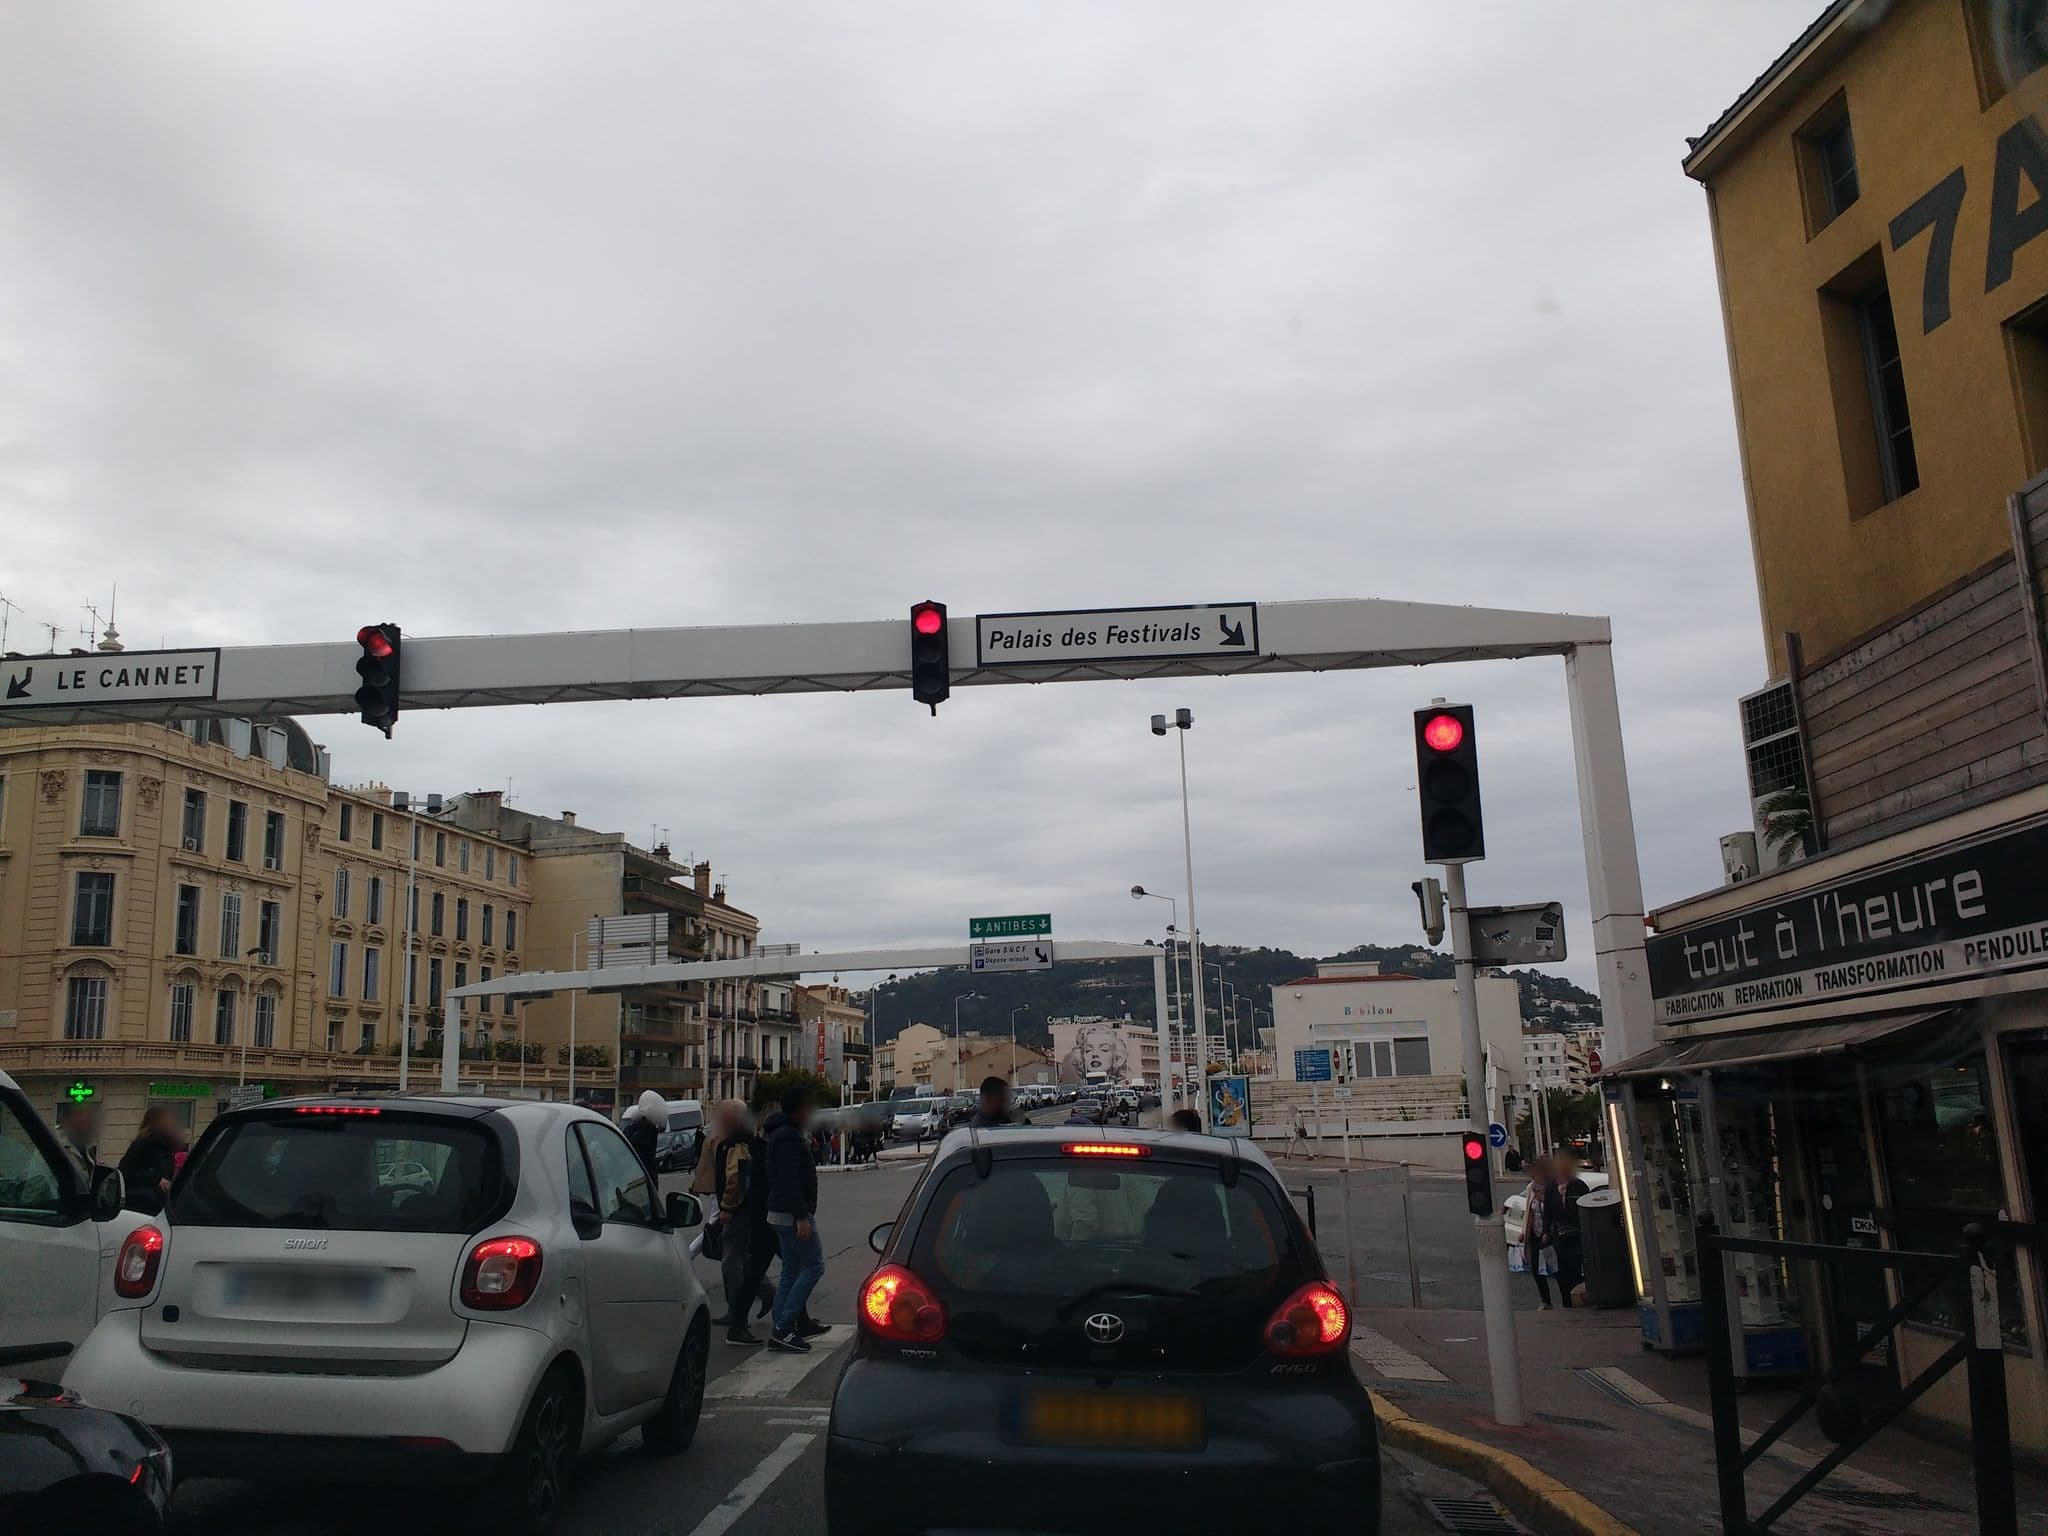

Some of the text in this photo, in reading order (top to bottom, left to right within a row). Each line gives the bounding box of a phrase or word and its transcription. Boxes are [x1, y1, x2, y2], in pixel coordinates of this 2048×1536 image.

[989, 622, 1202, 650] Palais des Festivals
[57, 665, 205, 690] LE CANNET
[986, 919, 1036, 933] ANTIBES
[1683, 869, 1986, 979] tout à l'heure
[984, 947, 1001, 955] Gare
[1665, 990, 1725, 1017] FABRICATION
[1735, 976, 1803, 1005] REPARATION
[1814, 948, 1946, 992] TRANSFORMATION
[284, 1238, 328, 1250] smart
